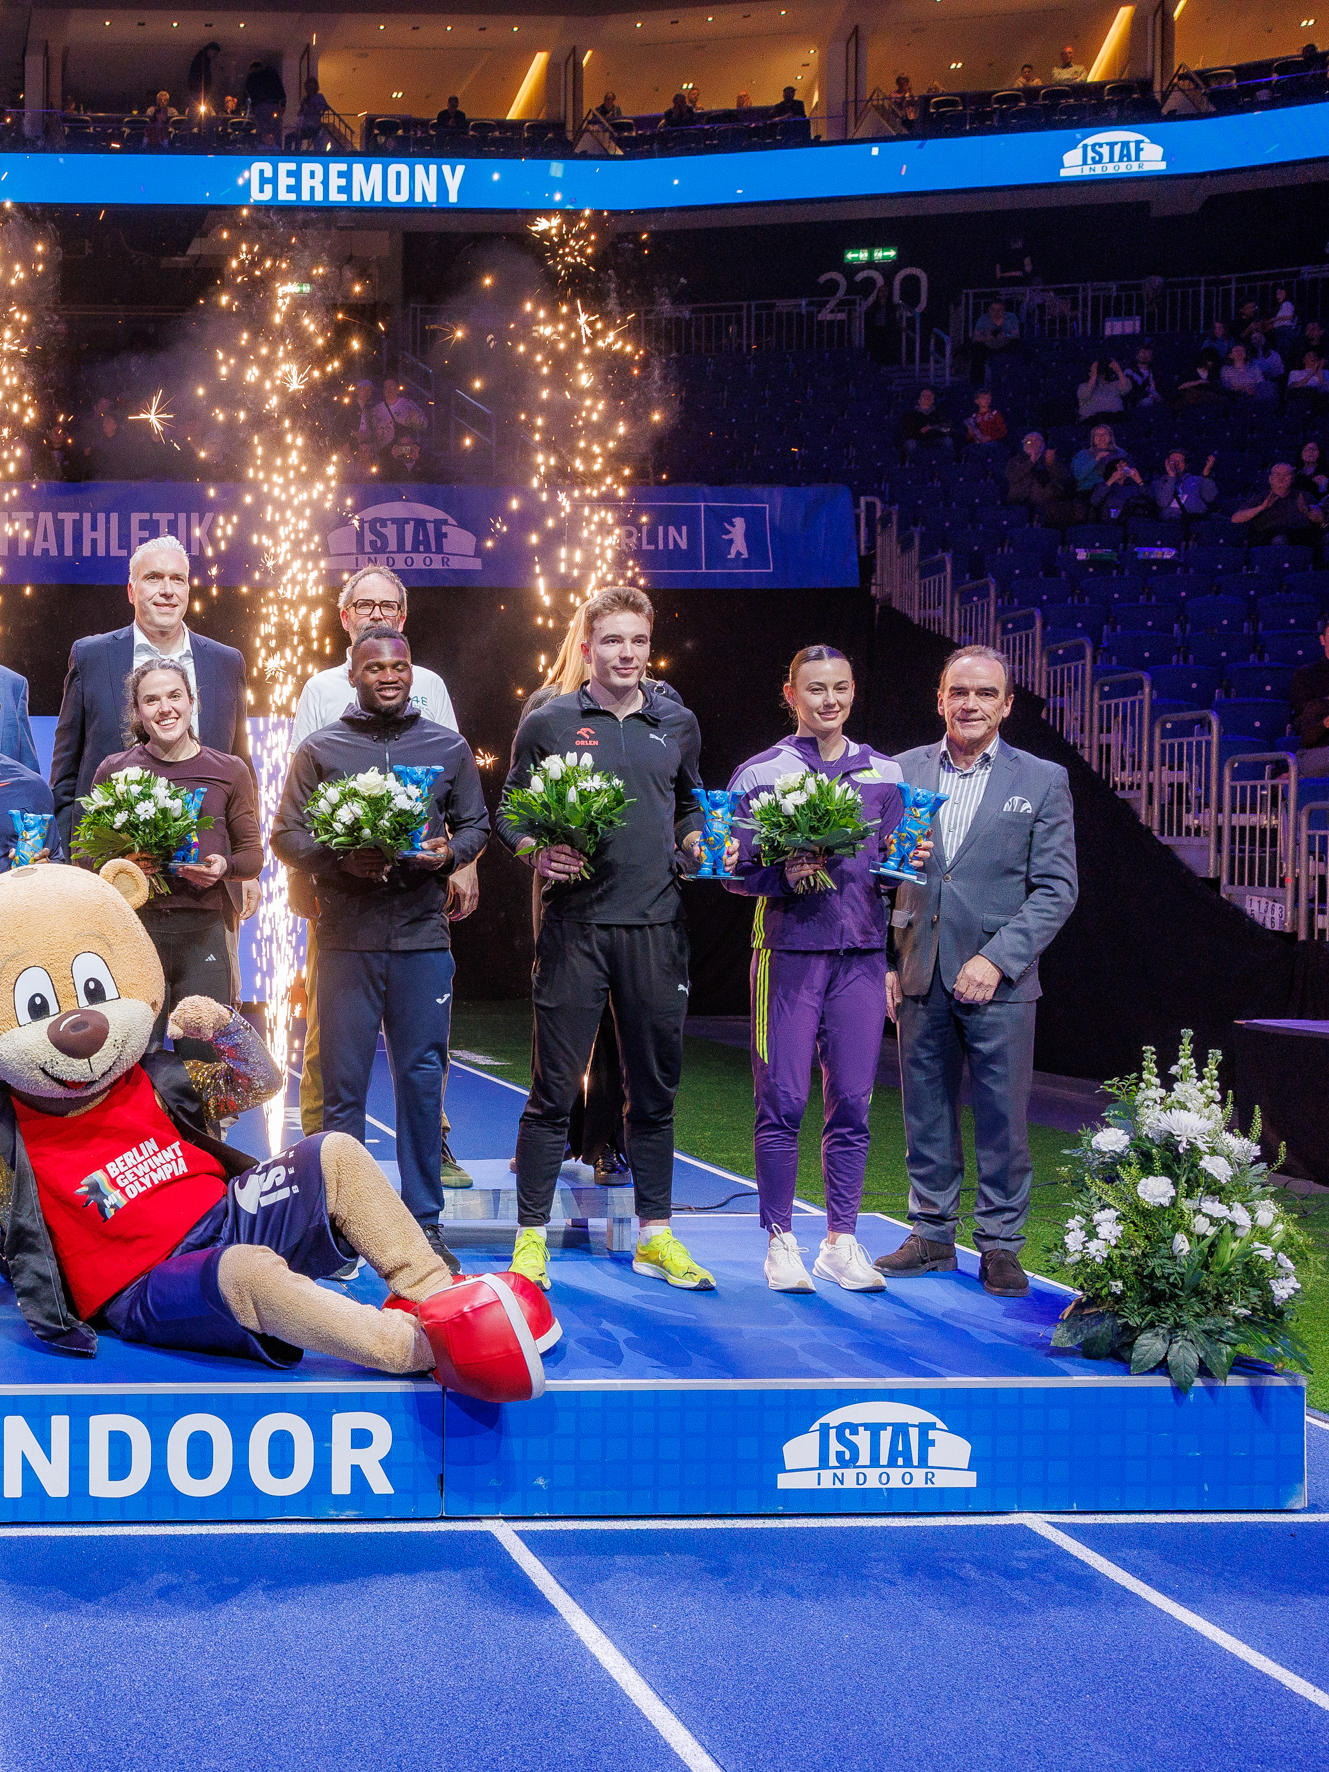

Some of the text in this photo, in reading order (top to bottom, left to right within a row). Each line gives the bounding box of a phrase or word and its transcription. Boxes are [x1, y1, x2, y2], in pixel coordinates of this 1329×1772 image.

[1081, 163, 1144, 174] INDOOR
[1082, 139, 1144, 165] ISTAF
[251, 162, 466, 203] CEREMONY
[817, 267, 928, 320] 220
[354, 517, 448, 554] ISTAF
[354, 555, 451, 568] INDOOR
[105, 1137, 159, 1179] BERLIN
[116, 1141, 183, 1187] GEWINNT
[103, 1157, 188, 1209] MIT OLYMPIA
[818, 1422, 937, 1467] ISTAF
[817, 1471, 935, 1486] INDOOR
